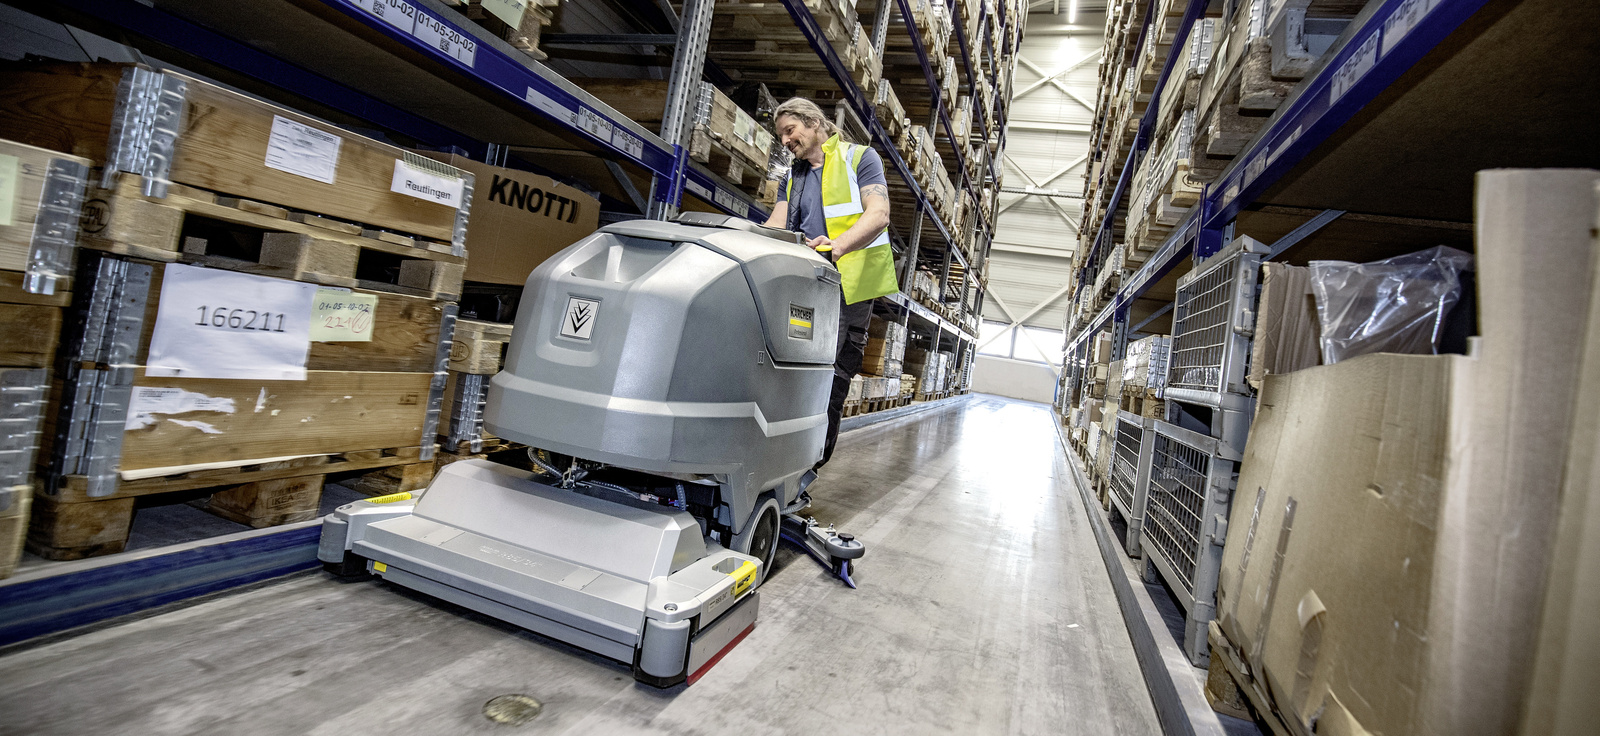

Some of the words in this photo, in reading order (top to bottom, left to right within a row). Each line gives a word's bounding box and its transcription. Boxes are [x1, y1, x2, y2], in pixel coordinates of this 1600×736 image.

[418, 13, 474, 53] 01-05-20-02
[579, 107, 612, 132] 01-05-10-03
[404, 179, 452, 200] Reutlingen
[195, 305, 285, 333] 166211
